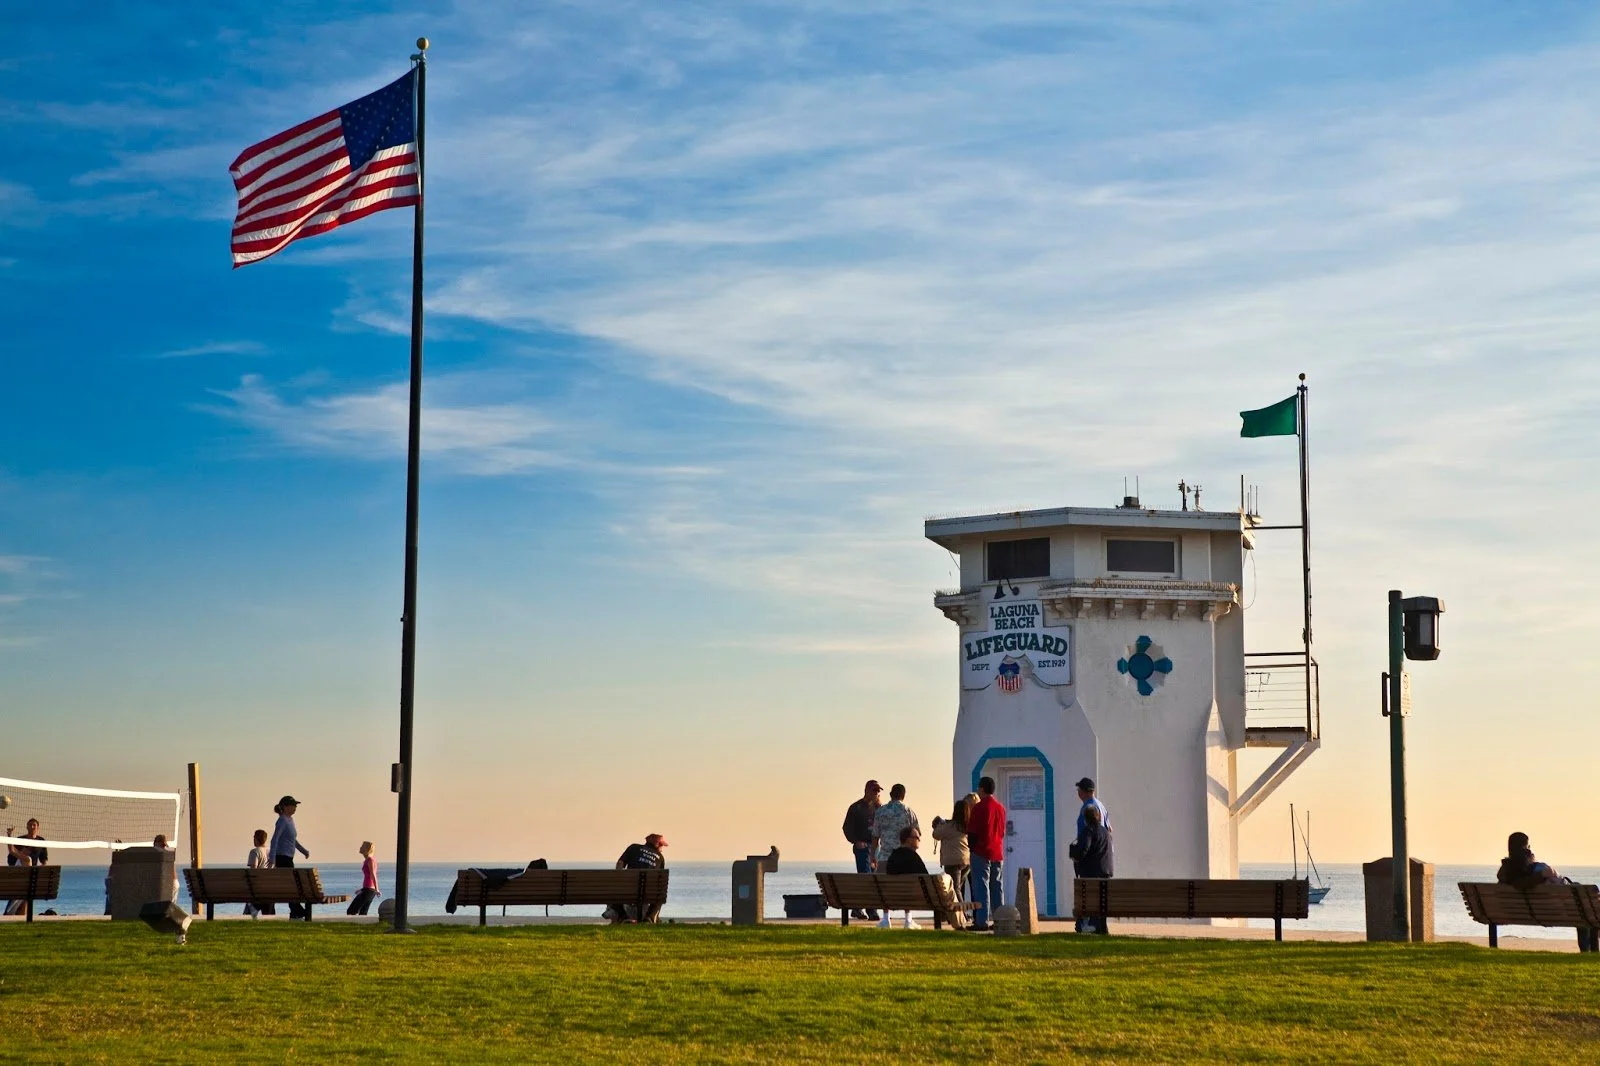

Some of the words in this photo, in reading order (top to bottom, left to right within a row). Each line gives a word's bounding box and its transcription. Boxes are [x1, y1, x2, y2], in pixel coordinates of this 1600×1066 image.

[990, 604, 1039, 618] LAGUNA
[995, 617, 1035, 630] BEACH
[965, 633, 1068, 660] LIFEGUARD
